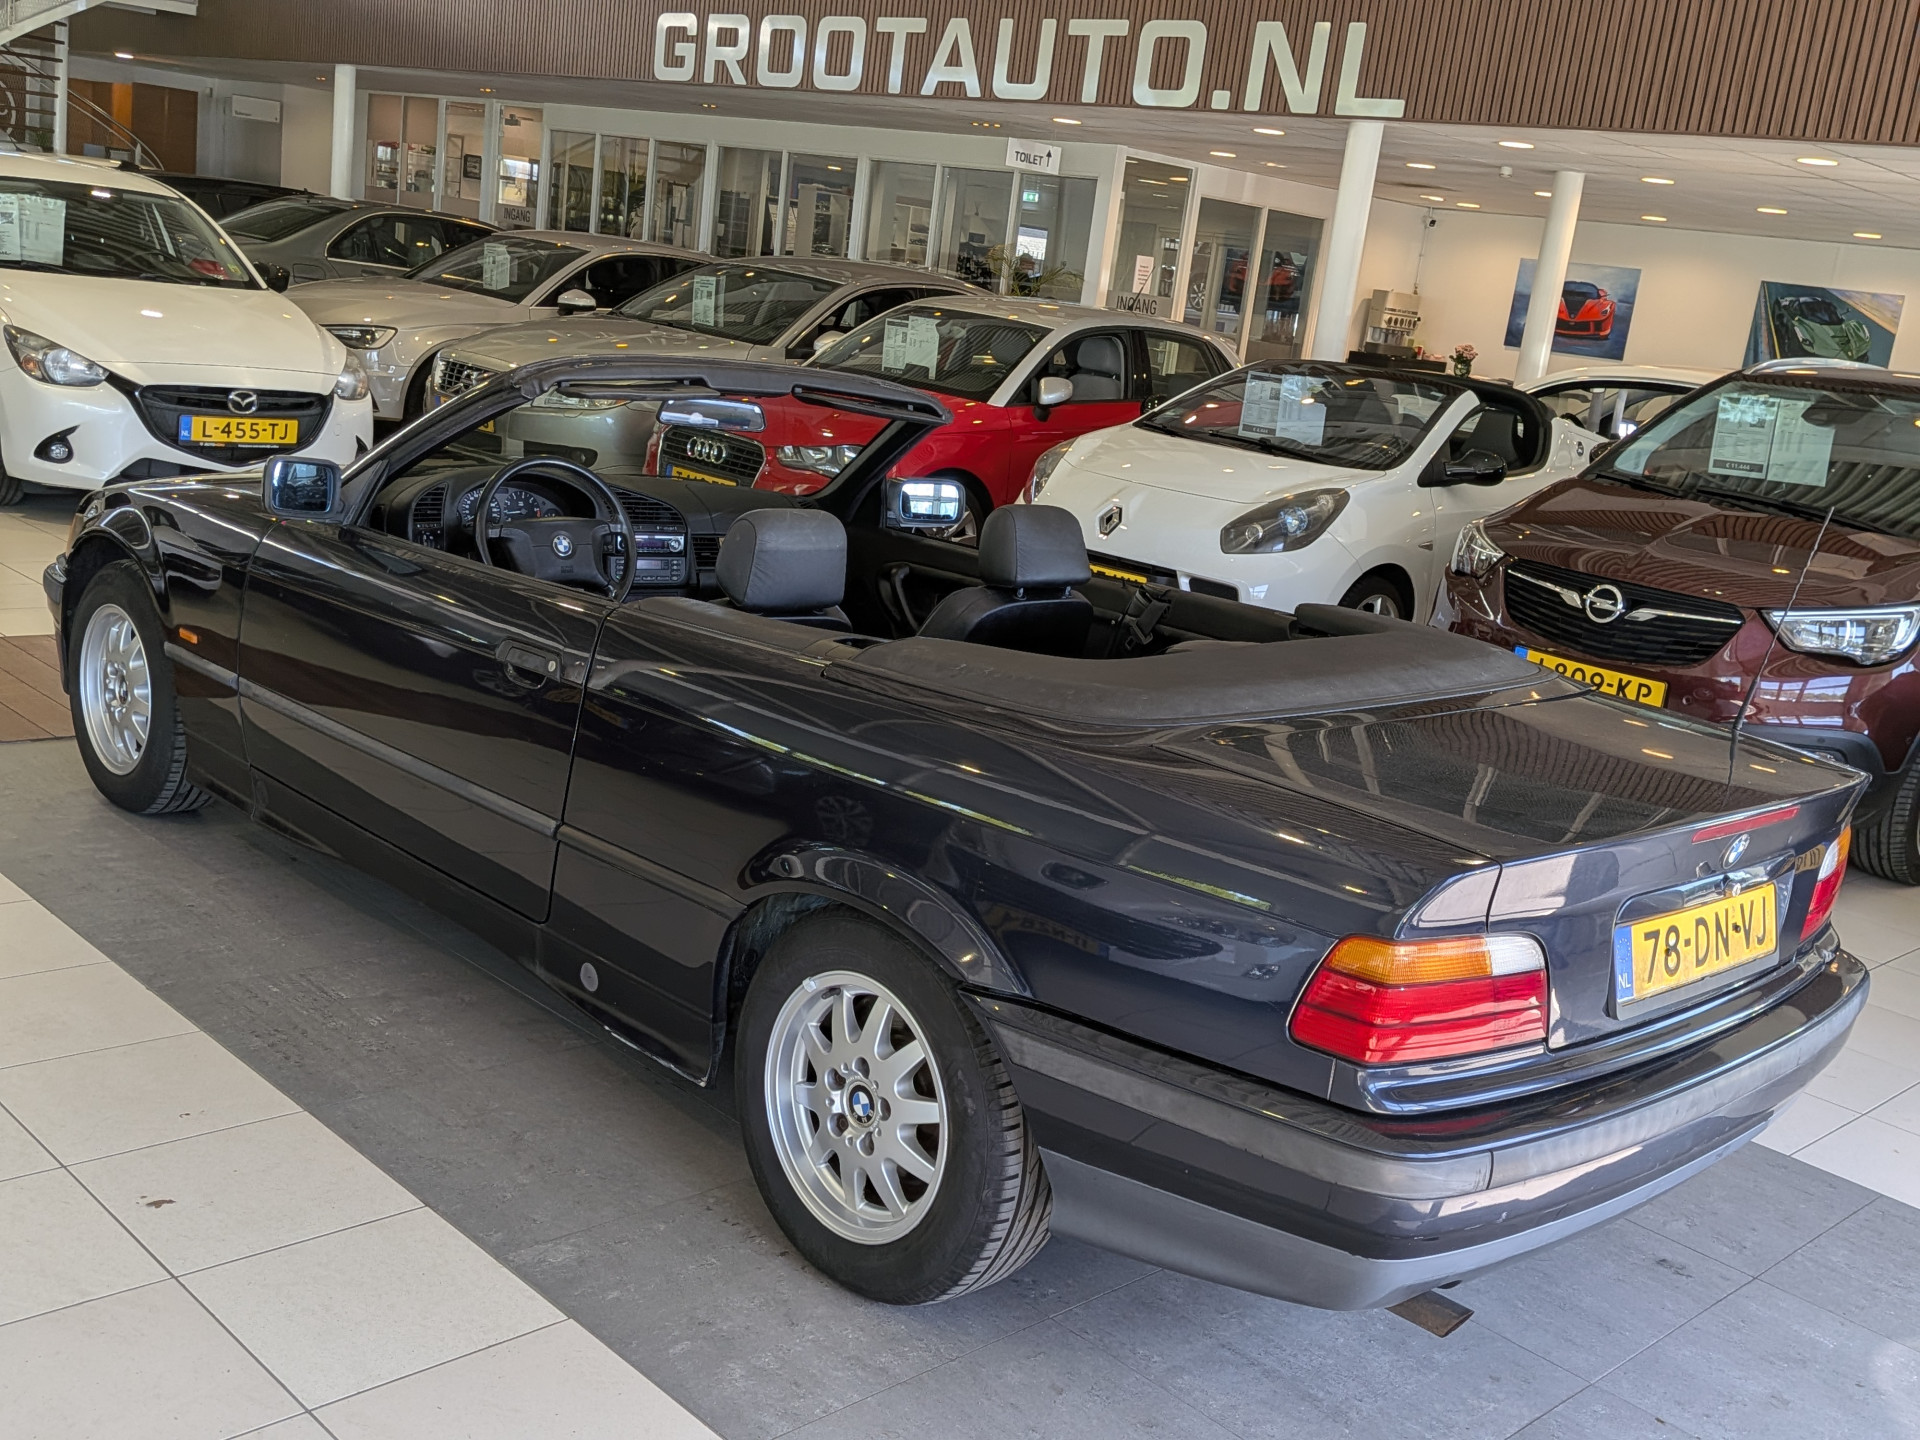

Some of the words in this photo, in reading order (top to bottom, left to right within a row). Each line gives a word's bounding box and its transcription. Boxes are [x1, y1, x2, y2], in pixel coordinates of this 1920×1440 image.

[654, 13, 1405, 118] GROOTAUTO.NL
[1015, 150, 1044, 166] TOILET
[503, 207, 531, 222] INGANG
[202, 421, 288, 440] L-455-TJ
[1539, 658, 1652, 701] 809-KP
[1644, 896, 1766, 984] 78-DN-VJ
[1618, 973, 1631, 989] NL
